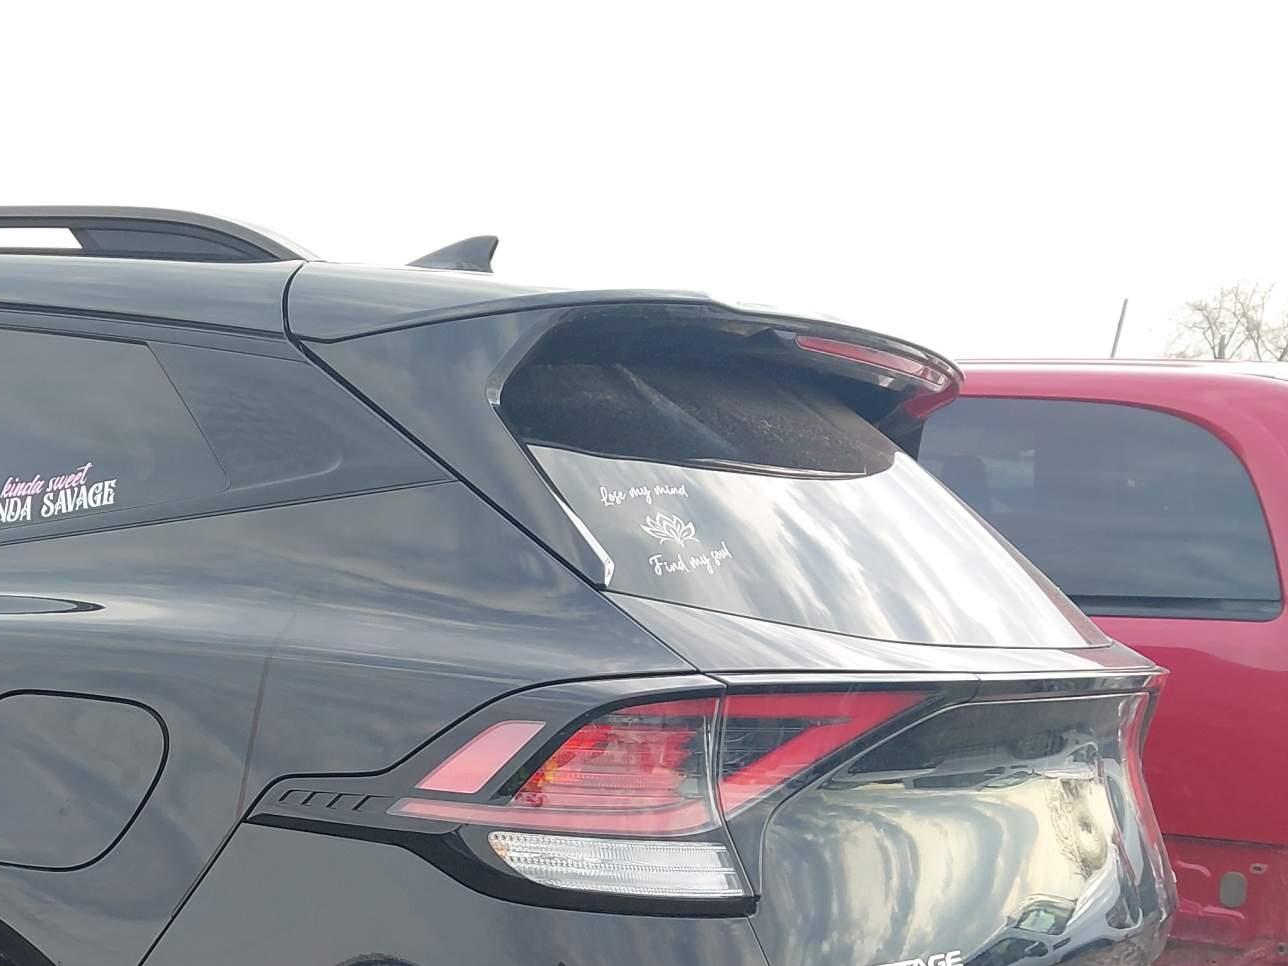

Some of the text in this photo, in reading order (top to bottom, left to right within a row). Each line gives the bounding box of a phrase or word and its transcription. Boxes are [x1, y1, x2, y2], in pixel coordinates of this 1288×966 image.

[0, 462, 93, 498] kinda sweet
[600, 484, 689, 506] Lose my mind
[40, 479, 117, 517] SAVAGE
[649, 541, 732, 575] Find my soul
